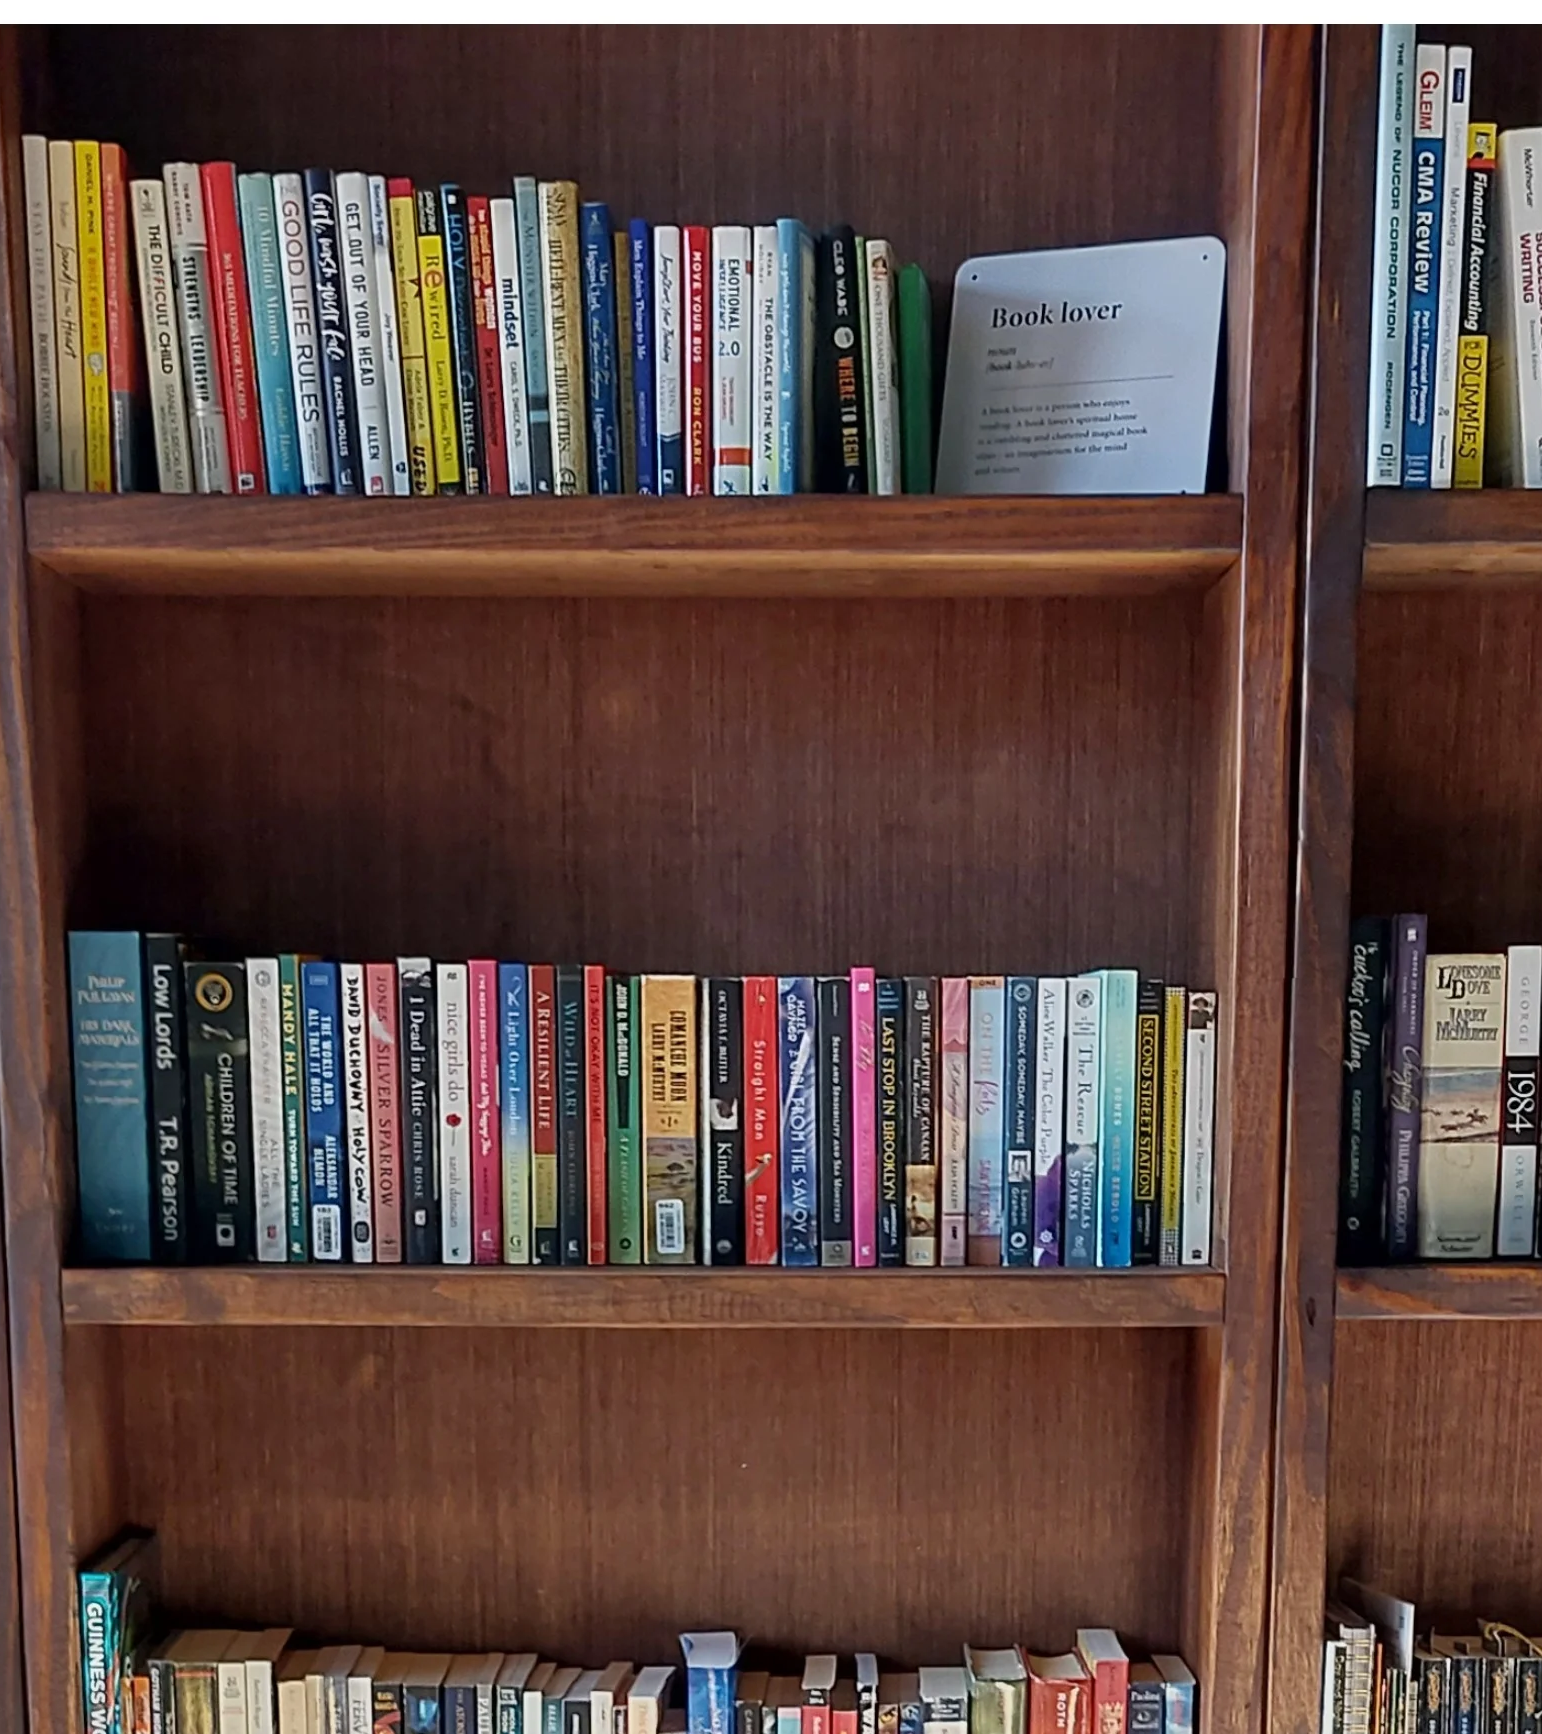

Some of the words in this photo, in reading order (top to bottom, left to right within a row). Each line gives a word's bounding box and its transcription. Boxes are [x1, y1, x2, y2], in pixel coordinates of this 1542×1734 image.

[1417, 152, 1434, 204] CMA
[345, 203, 359, 230] GET
[1469, 172, 1487, 240] Financial
[283, 200, 305, 276] GOOD
[348, 238, 363, 265] OUT
[1414, 212, 1433, 294] Review
[353, 275, 366, 293] OF
[693, 251, 702, 289] MOVE
[1465, 245, 1484, 331] Accounting
[291, 285, 309, 336] LIFE
[502, 278, 518, 349] mindset
[693, 295, 702, 332] YOUR
[728, 259, 740, 332] EMOTIONAL
[765, 298, 773, 319] THE
[991, 303, 1053, 329] Book
[1062, 301, 1123, 323] lover
[354, 301, 370, 338] YOUR
[359, 347, 374, 386] HEAD
[693, 337, 702, 363] BUS
[765, 325, 773, 385] OBSTACLE
[297, 345, 319, 422] RULES
[693, 387, 702, 415] RON
[765, 391, 773, 400] IS
[765, 405, 773, 428] THE
[1457, 355, 1484, 458] DUMMIES
[367, 425, 380, 460] ALLEN
[693, 422, 702, 464] CLARK
[764, 431, 773, 461] WAY
[153, 964, 172, 1009] Low
[155, 1012, 177, 1069] Lords
[447, 1002, 463, 1036] nice
[443, 1040, 463, 1075] girls
[1141, 1019, 1154, 1076] SECOND
[378, 1044, 392, 1109] SILVER
[448, 1081, 464, 1101] do
[753, 1040, 766, 1101] Straight
[217, 1054, 234, 1135] CHILDREN
[1140, 1080, 1152, 1133] STREET
[1507, 1071, 1535, 1133] 1984
[159, 1117, 178, 1155] T.R.
[754, 1107, 767, 1140] Man
[222, 1141, 235, 1160] OF
[379, 1118, 393, 1207] SPARROW
[1139, 1136, 1152, 1195] STATION
[224, 1164, 237, 1205] TIME
[717, 1143, 733, 1204] Kindred
[160, 1160, 179, 1240] Pearson
[85, 1603, 105, 1704] GUINNESS
